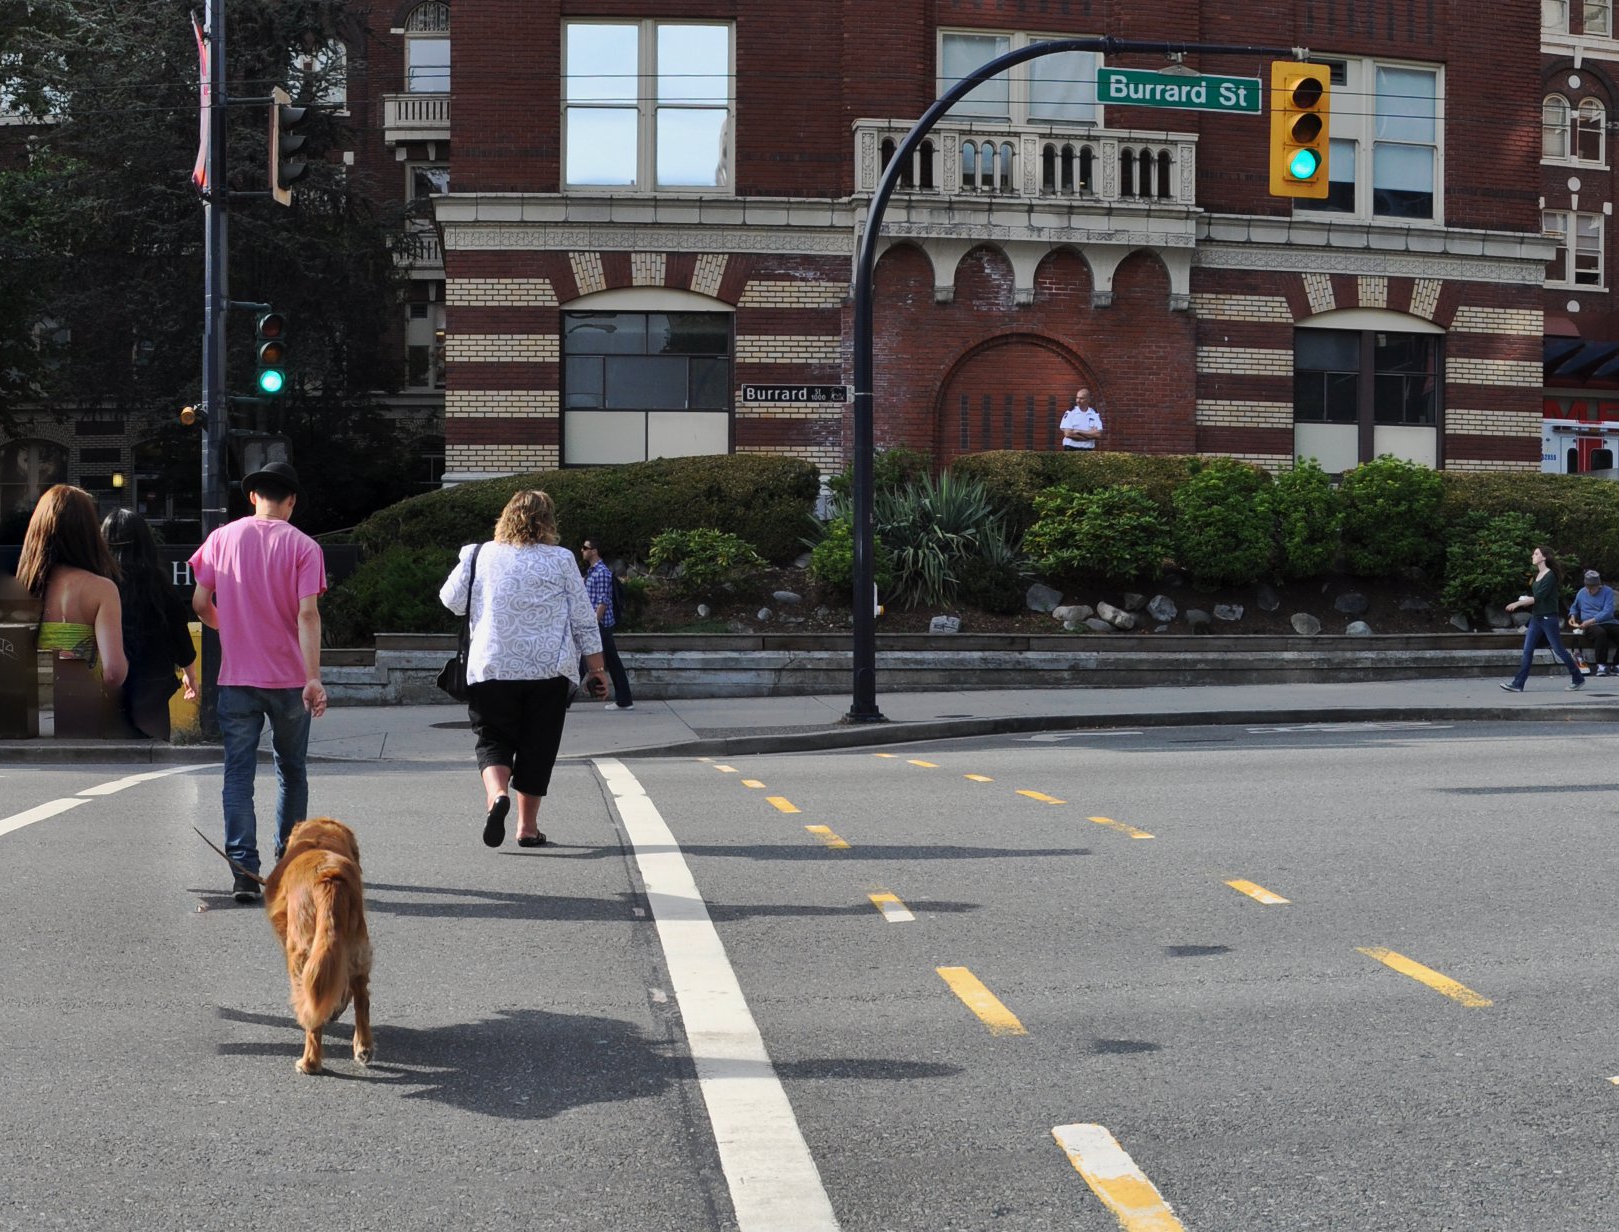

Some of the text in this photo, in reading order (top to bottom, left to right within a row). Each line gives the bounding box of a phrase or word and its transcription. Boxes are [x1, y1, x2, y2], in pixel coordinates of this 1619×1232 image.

[1109, 74, 1248, 106] Burrard St
[746, 388, 808, 401] Burrard
